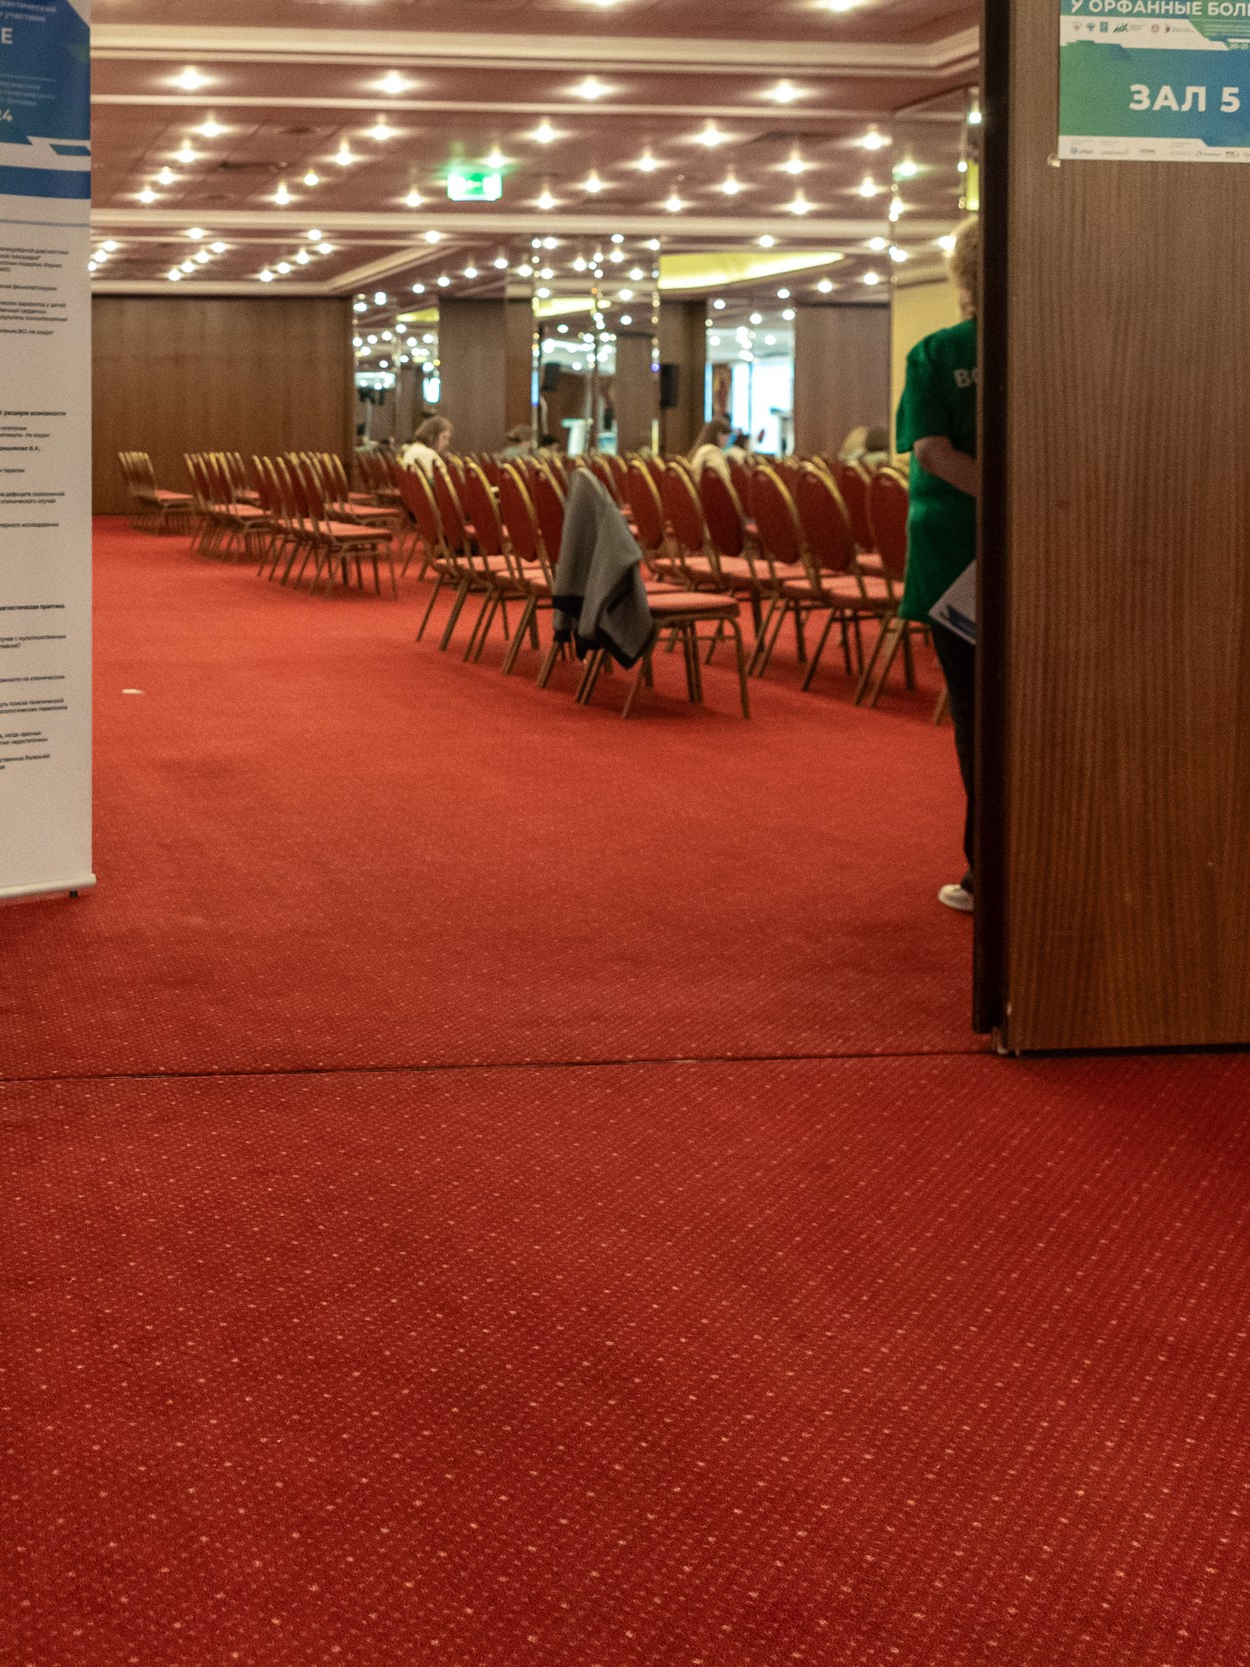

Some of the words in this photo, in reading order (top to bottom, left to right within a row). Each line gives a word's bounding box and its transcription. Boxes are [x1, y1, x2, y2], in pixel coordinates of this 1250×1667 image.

[1089, 0, 1202, 15] ОРФАННЫЕ
[1129, 83, 1206, 112] ЗАЛ
[1220, 87, 1240, 113] 5
